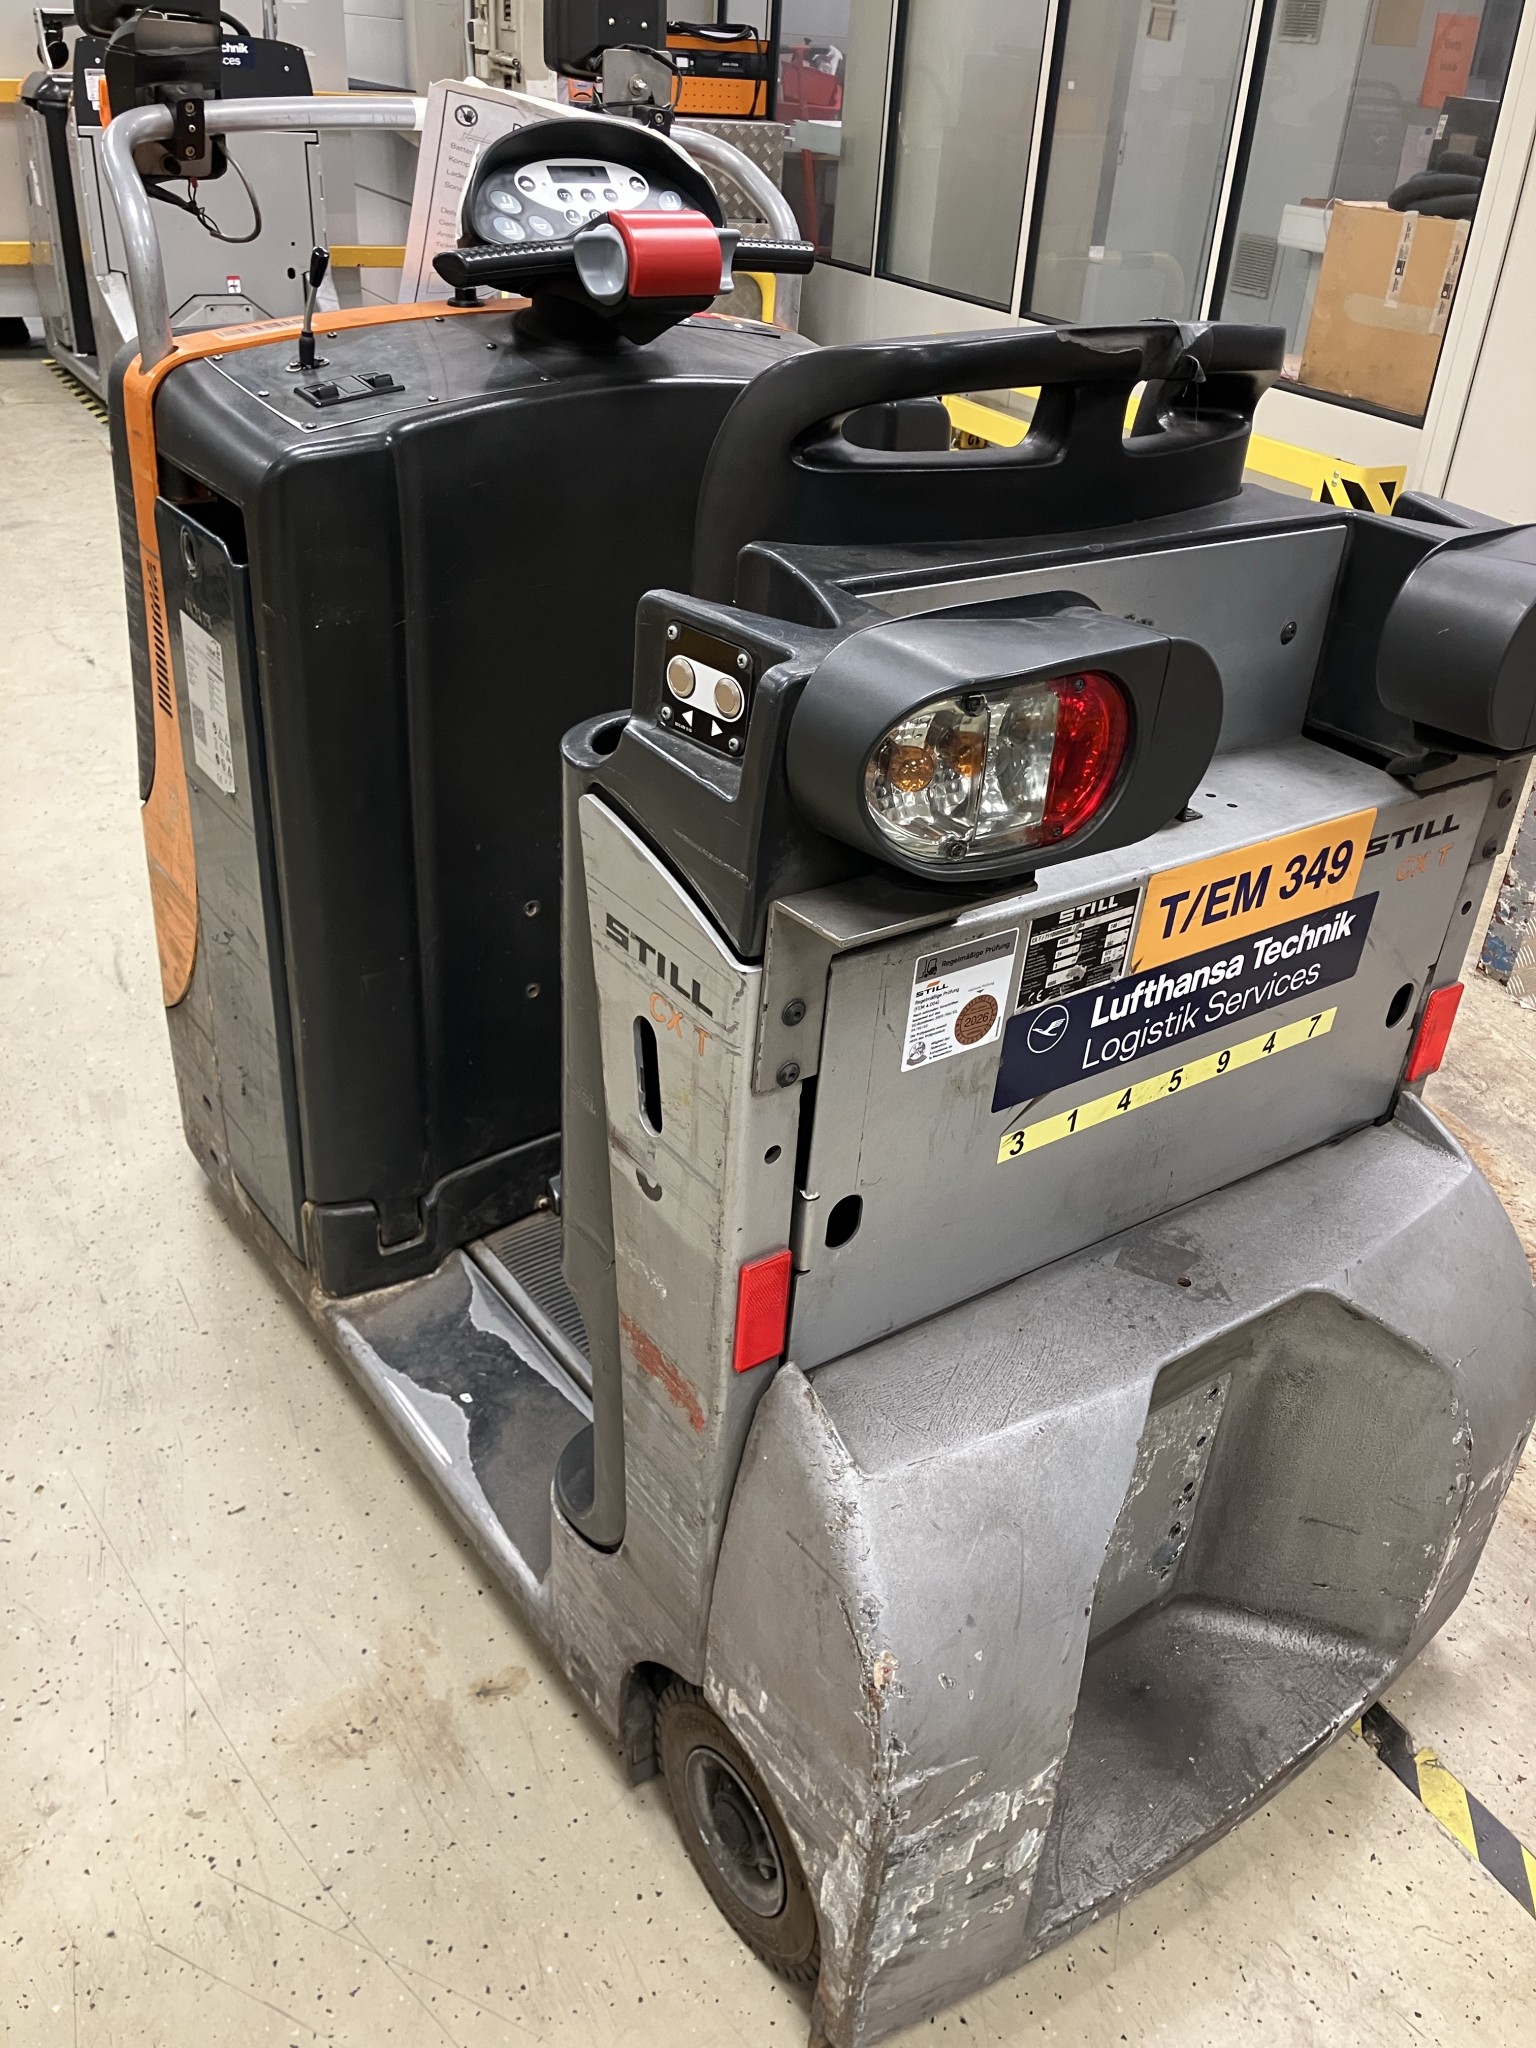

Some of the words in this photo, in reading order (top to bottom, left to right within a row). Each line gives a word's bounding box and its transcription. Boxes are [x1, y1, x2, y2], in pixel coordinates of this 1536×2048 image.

[1365, 814, 1460, 858] STILL
[1396, 854, 1428, 881] CX
[1438, 843, 1455, 866] T
[1058, 896, 1118, 924] STILL
[1160, 864, 1272, 939] T/EM
[1278, 839, 1354, 899] 349
[606, 912, 713, 1018] STILL
[941, 948, 984, 968] Regelmäßige
[985, 941, 1011, 955] Prüfung
[1091, 954, 1245, 1028] Lufthansa
[1252, 910, 1356, 970] Technik
[915, 983, 949, 998] STILL
[1081, 1010, 1200, 1071] Logistik
[1204, 962, 1321, 1023] Services
[650, 992, 684, 1039] CX
[693, 1024, 714, 1056] T
[964, 1012, 990, 1028] 2026
[1009, 1131, 1025, 1156] 3
[1067, 1109, 1079, 1133] 1
[1117, 1088, 1132, 1112] 4
[1168, 1068, 1184, 1093] 5
[1216, 1050, 1231, 1074] 9
[1262, 1031, 1276, 1055] 4
[1306, 1014, 1322, 1038] 7
